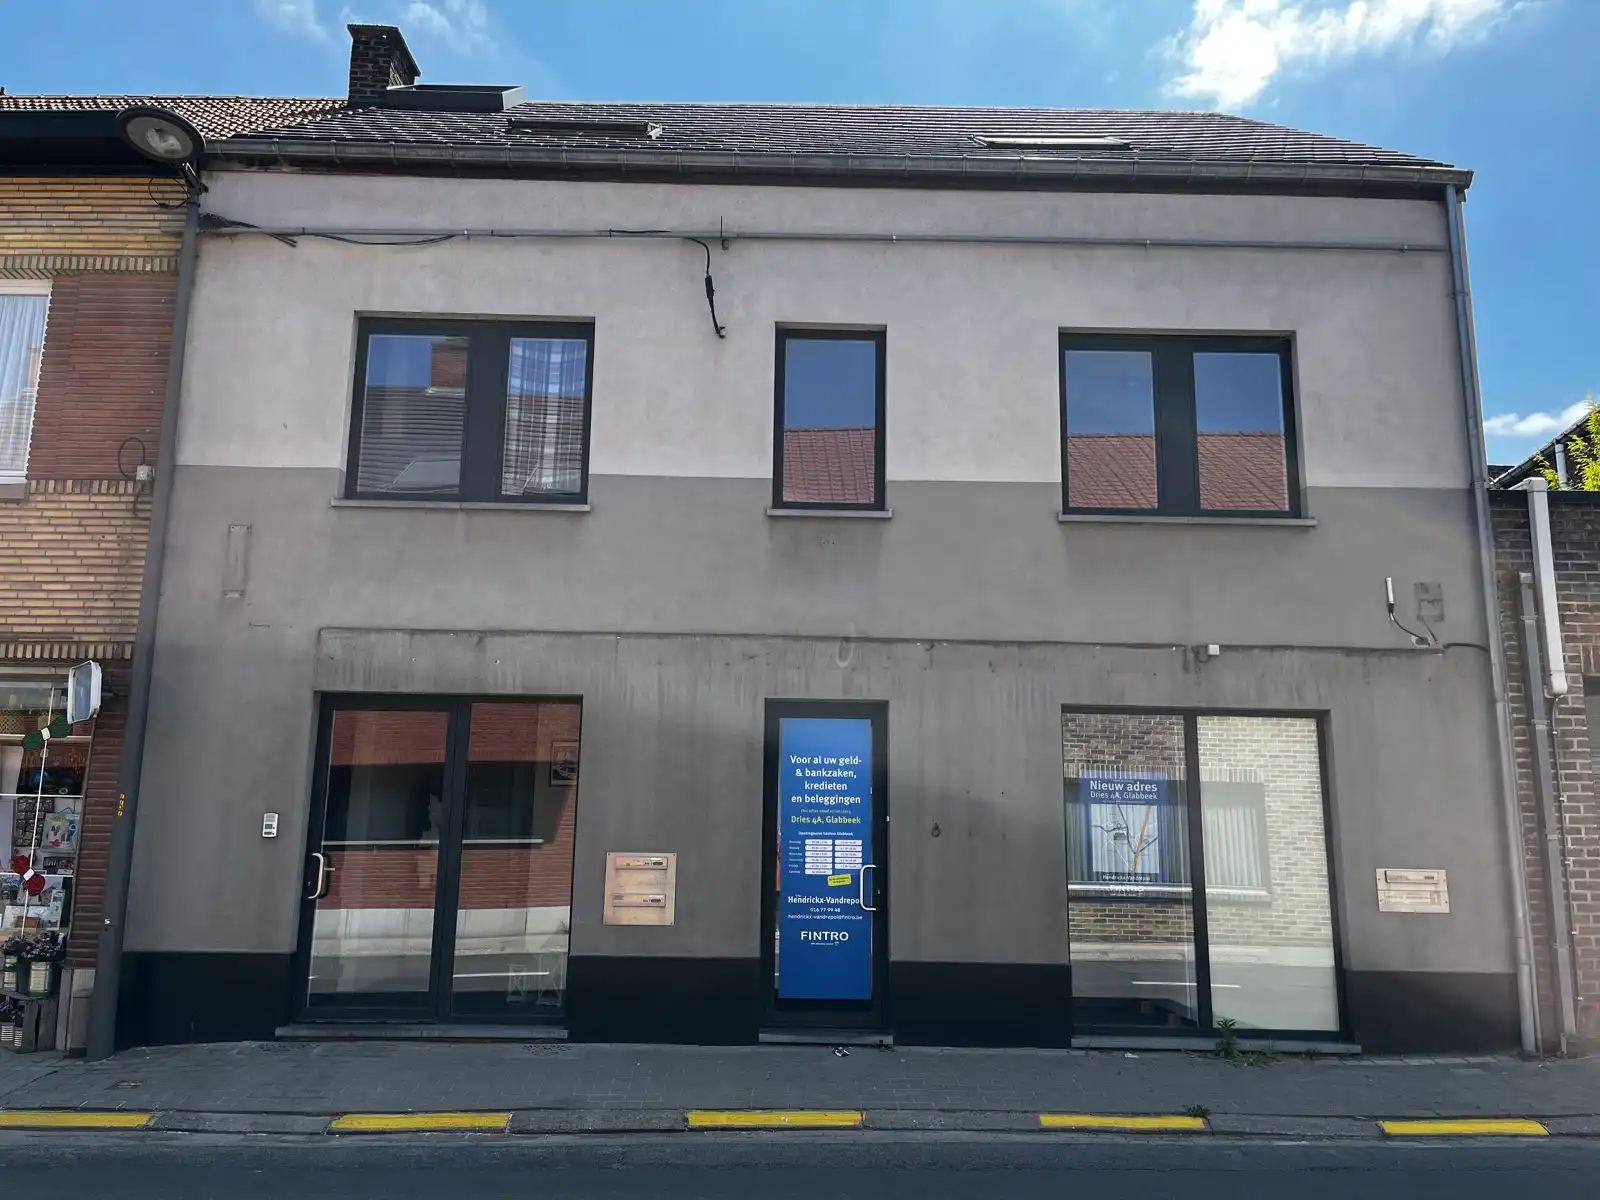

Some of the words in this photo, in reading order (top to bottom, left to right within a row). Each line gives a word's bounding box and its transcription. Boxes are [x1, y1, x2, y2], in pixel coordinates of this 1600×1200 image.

[790, 755, 811, 764] Voor
[813, 755, 822, 764] al
[839, 755, 862, 766] geld-
[795, 768, 803, 777] &
[805, 768, 857, 779] bankzaken,
[804, 781, 848, 790] kredieten
[1090, 780, 1124, 791] Nieuw
[1127, 782, 1158, 792] adres
[791, 795, 802, 803] en
[804, 794, 861, 806] beleggingen
[1090, 790, 1109, 799] Dries
[1110, 791, 1122, 800] 4A,
[1123, 792, 1158, 800] Glabbeek
[791, 815, 811, 823] Dries
[812, 816, 824, 825] 4A,
[826, 815, 862, 824] Glabbeek
[788, 895, 860, 905] Hendrickx-Vandrepo
[800, 931, 849, 941] FINTRO
